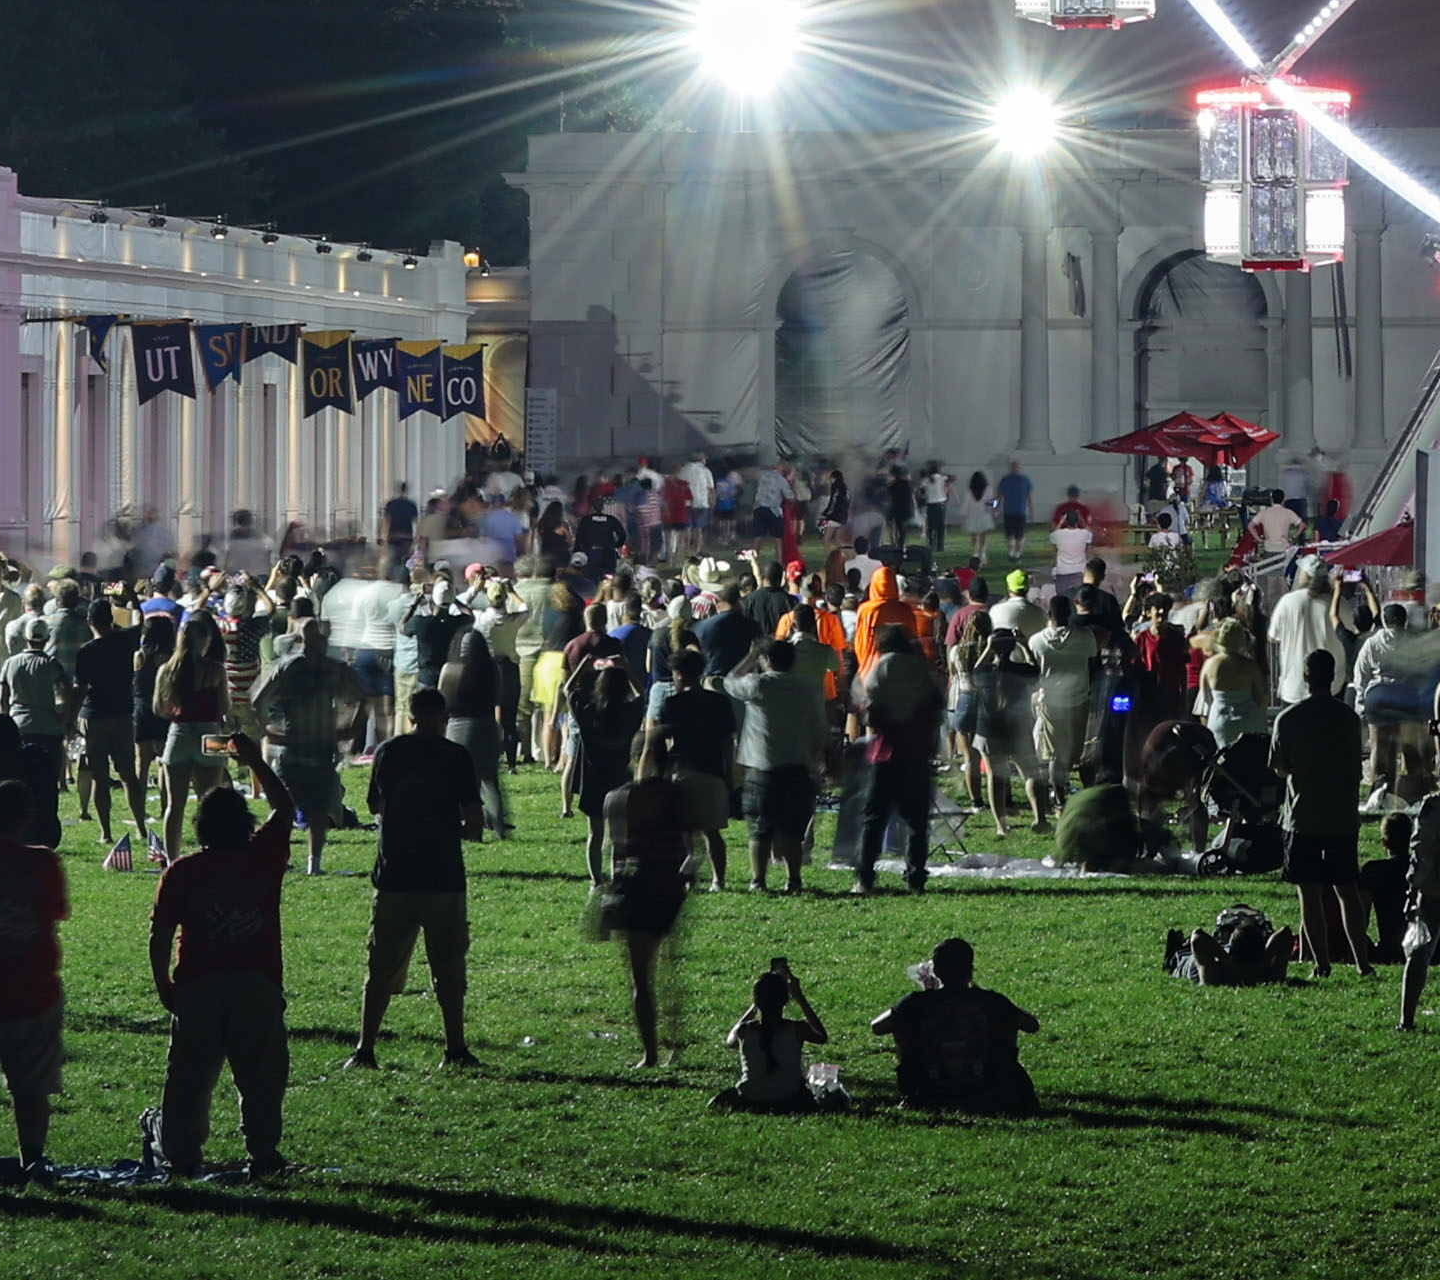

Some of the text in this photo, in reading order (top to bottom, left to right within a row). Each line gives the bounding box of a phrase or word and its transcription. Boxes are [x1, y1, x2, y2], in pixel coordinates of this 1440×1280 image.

[146, 345, 181, 382] UT
[356, 348, 394, 382] WY
[309, 367, 345, 399] OR
[406, 373, 435, 404] NE
[446, 376, 478, 406] CO
